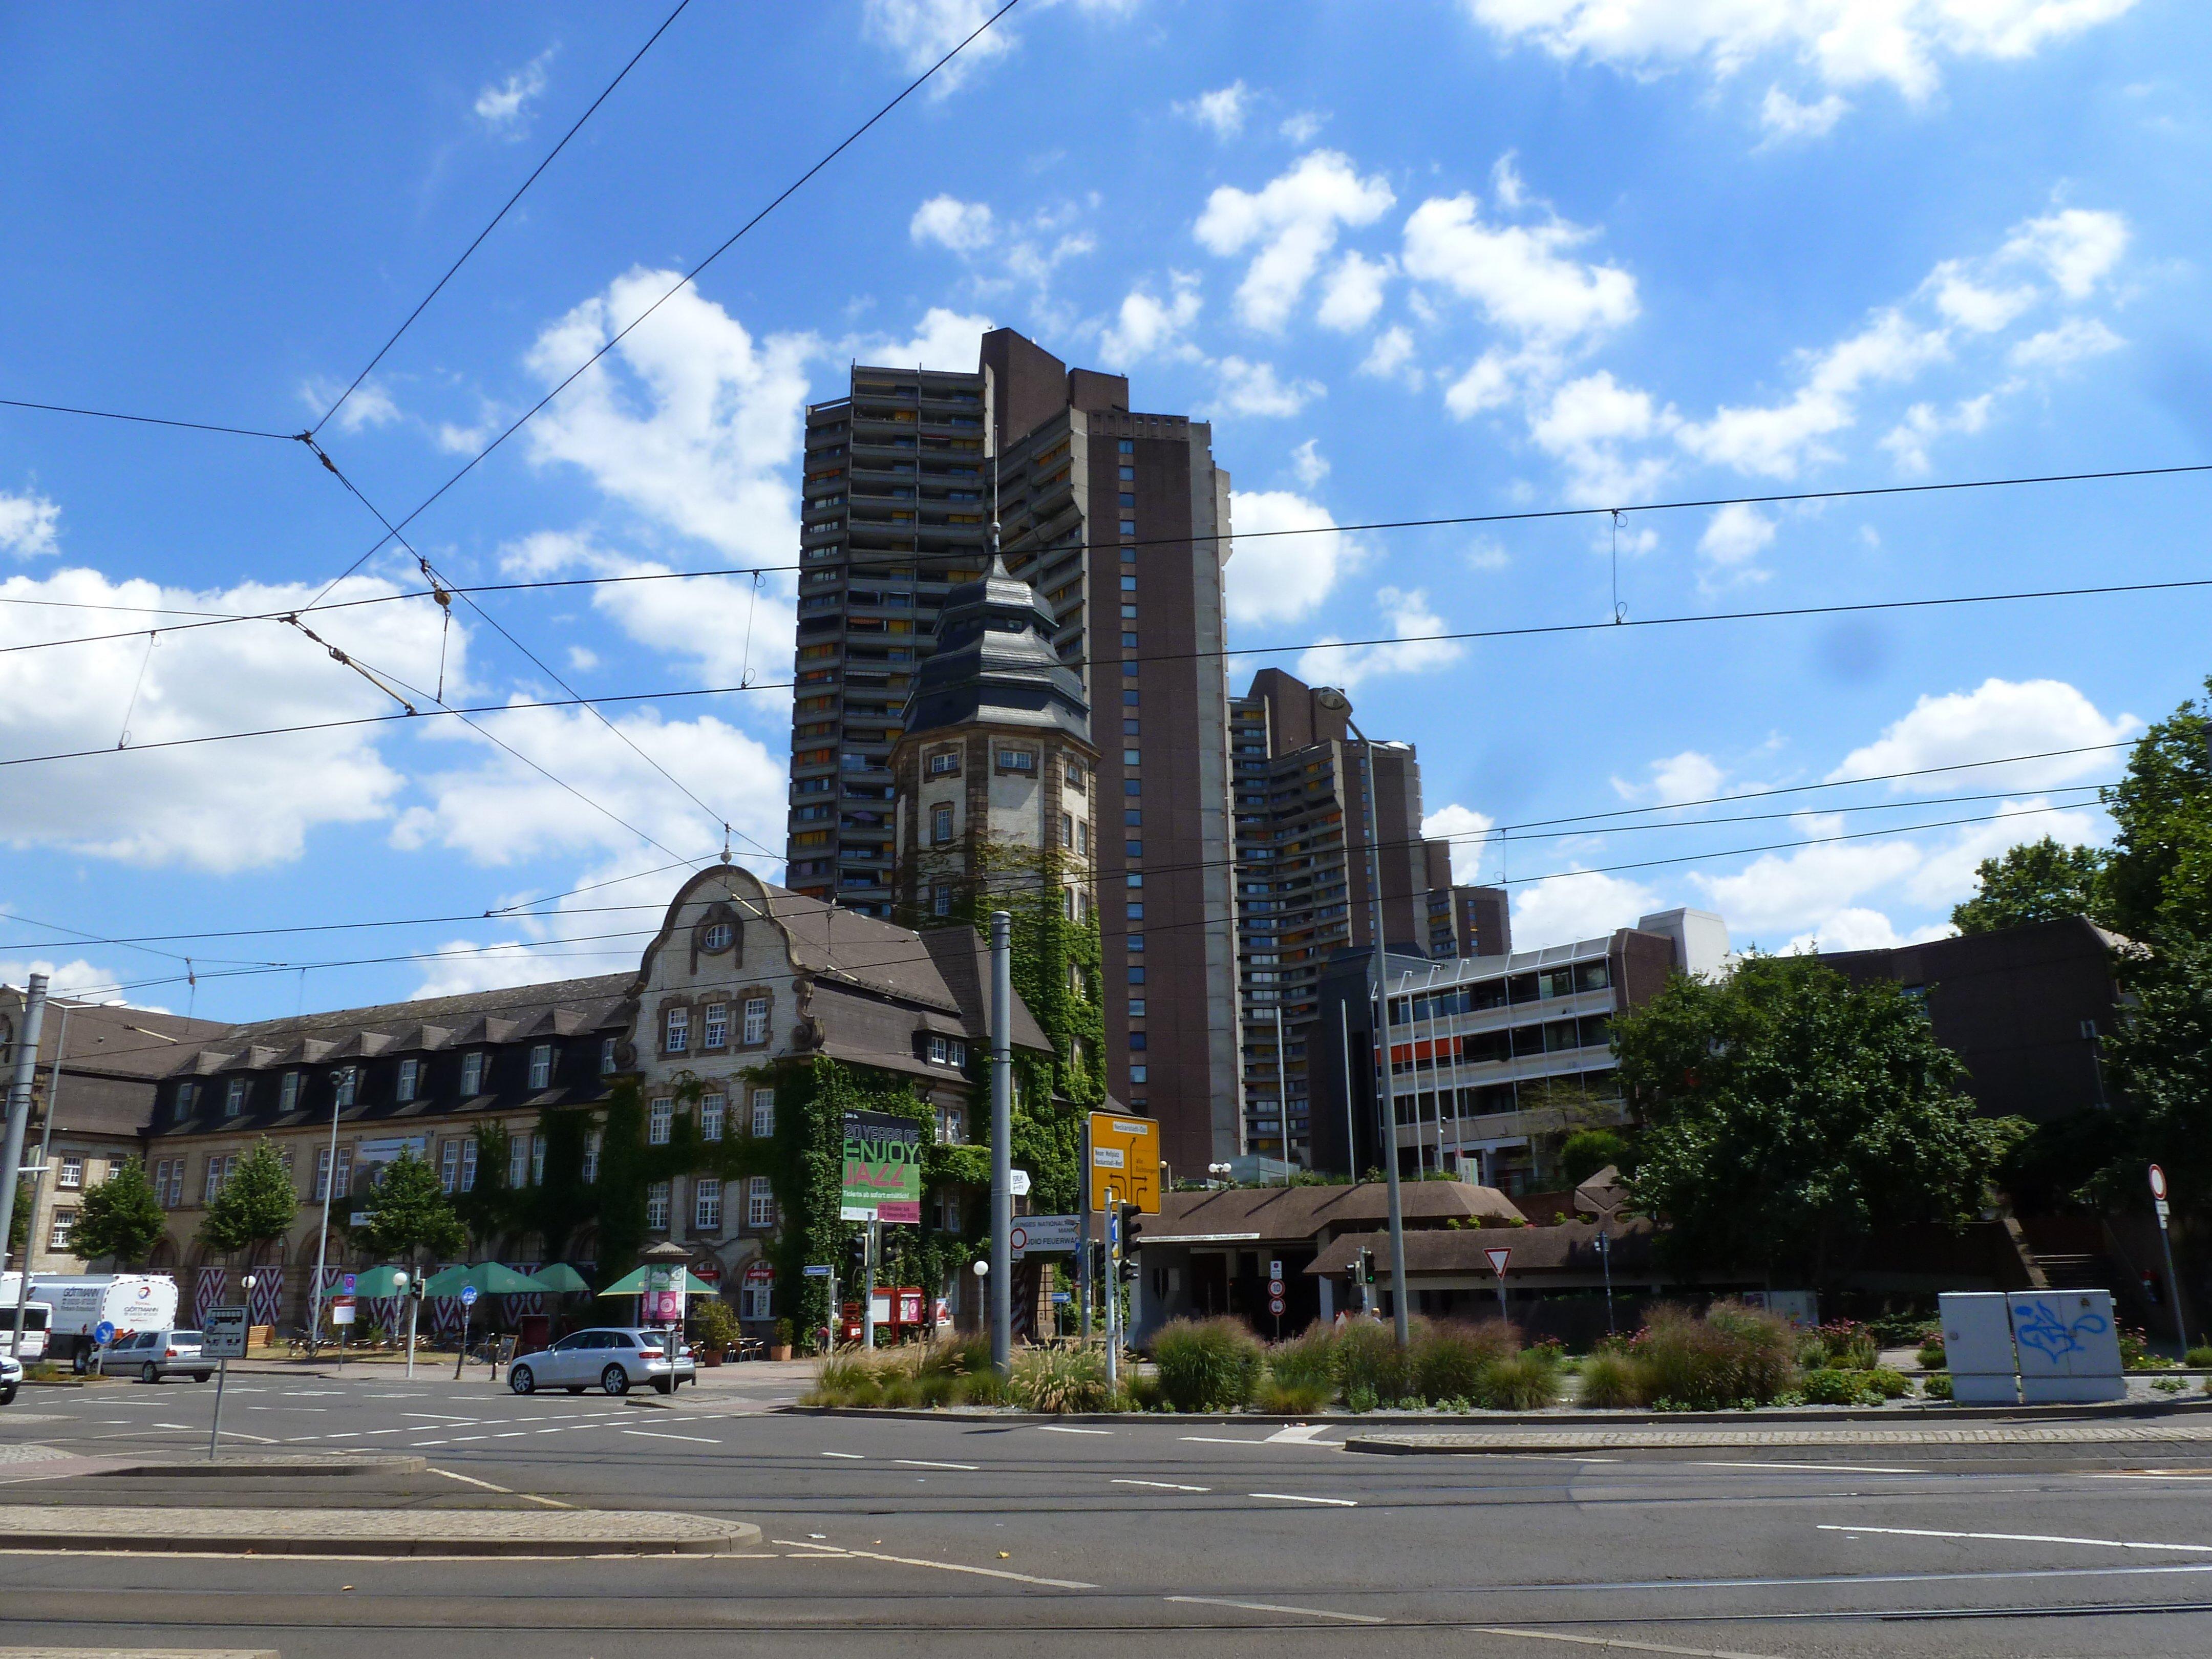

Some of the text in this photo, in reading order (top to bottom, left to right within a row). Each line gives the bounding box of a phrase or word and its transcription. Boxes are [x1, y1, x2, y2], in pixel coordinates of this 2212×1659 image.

[844, 1123, 919, 1146] 20 YEARS OF
[843, 1138, 920, 1164] ENJOY
[843, 1161, 904, 1187] JAZZ
[1043, 1237, 1079, 1245] FEUERWAC
[1273, 1283, 1280, 1292] 10
